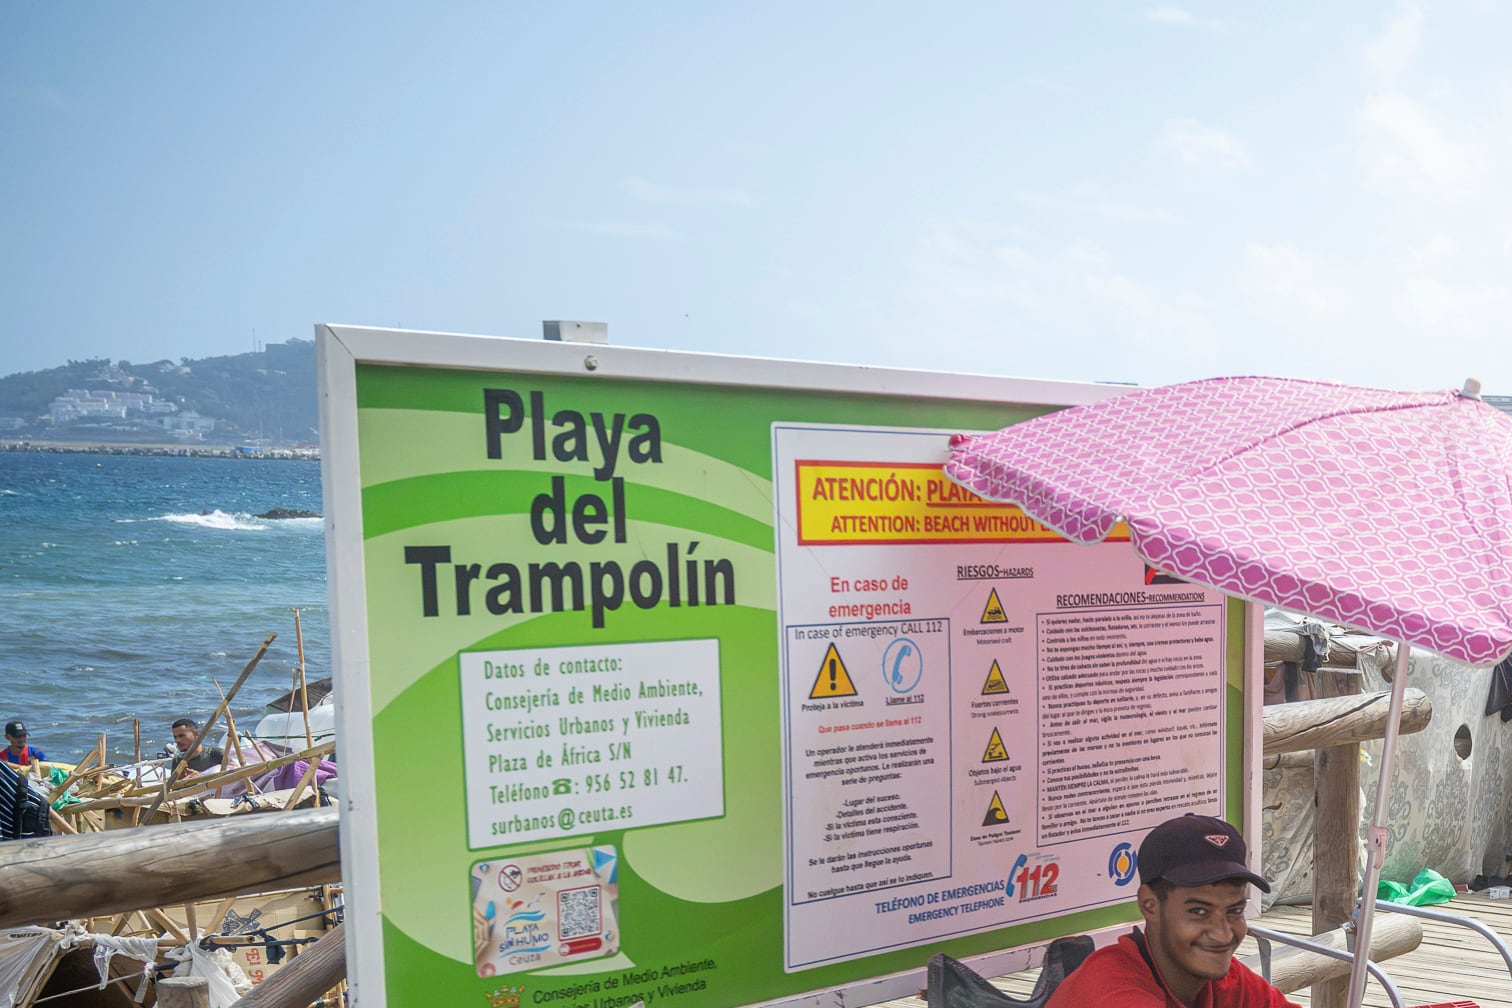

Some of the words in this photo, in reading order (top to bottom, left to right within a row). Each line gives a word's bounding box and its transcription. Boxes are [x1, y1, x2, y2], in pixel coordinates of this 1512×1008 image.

[484, 388, 663, 482] Playa
[813, 473, 921, 502] ATENCIÓN:
[530, 476, 627, 545] del
[831, 515, 921, 533] ATTENTION:
[924, 515, 971, 533] BEACH
[974, 514, 1035, 532] WITHOUT
[404, 541, 736, 628] Trampolín
[830, 577, 850, 593] En
[855, 578, 888, 591] caso
[891, 575, 909, 590] de
[829, 599, 911, 620] emergencia
[795, 629, 805, 640] In
[807, 629, 829, 640] case
[832, 627, 843, 638] of
[845, 625, 898, 638] emergency
[901, 623, 924, 634] CALL
[926, 621, 943, 633] 112
[484, 660, 525, 680] Datos
[534, 658, 550, 676] de
[559, 658, 623, 675] contacto:
[485, 688, 559, 714] Consejería
[568, 686, 584, 704] de
[593, 682, 631, 702] Medio
[638, 679, 703, 699] Ambiente,
[802, 704, 825, 712] Proteja
[914, 695, 924, 703] 112
[487, 721, 550, 742] Servicios
[559, 716, 614, 735] Urbanos
[622, 717, 629, 735] y
[635, 708, 690, 729] Vivienda
[911, 716, 921, 724] 112
[488, 753, 527, 773] Plaza
[536, 750, 552, 768] de
[561, 742, 600, 766] África
[609, 742, 631, 761] S/N
[586, 773, 611, 793] 956
[620, 771, 635, 790] 52
[644, 768, 658, 786] 81
[668, 766, 688, 784] 47.
[492, 804, 632, 835] surbanos@ceuta.es
[1016, 862, 1059, 900] 112
[875, 896, 925, 915] TELÉFONO
[927, 892, 940, 904] DE
[941, 879, 1005, 902] EMERGENCIAS
[908, 907, 958, 924] EMERGENCY
[961, 896, 1005, 914] TELEPHONE
[506, 924, 539, 942] PLAYA
[509, 954, 541, 965] Ceuta
[604, 977, 619, 991] de
[622, 970, 658, 987] Medio
[660, 958, 717, 979] Ambiente,
[648, 990, 655, 1002] y
[657, 979, 706, 998] Vivienda
